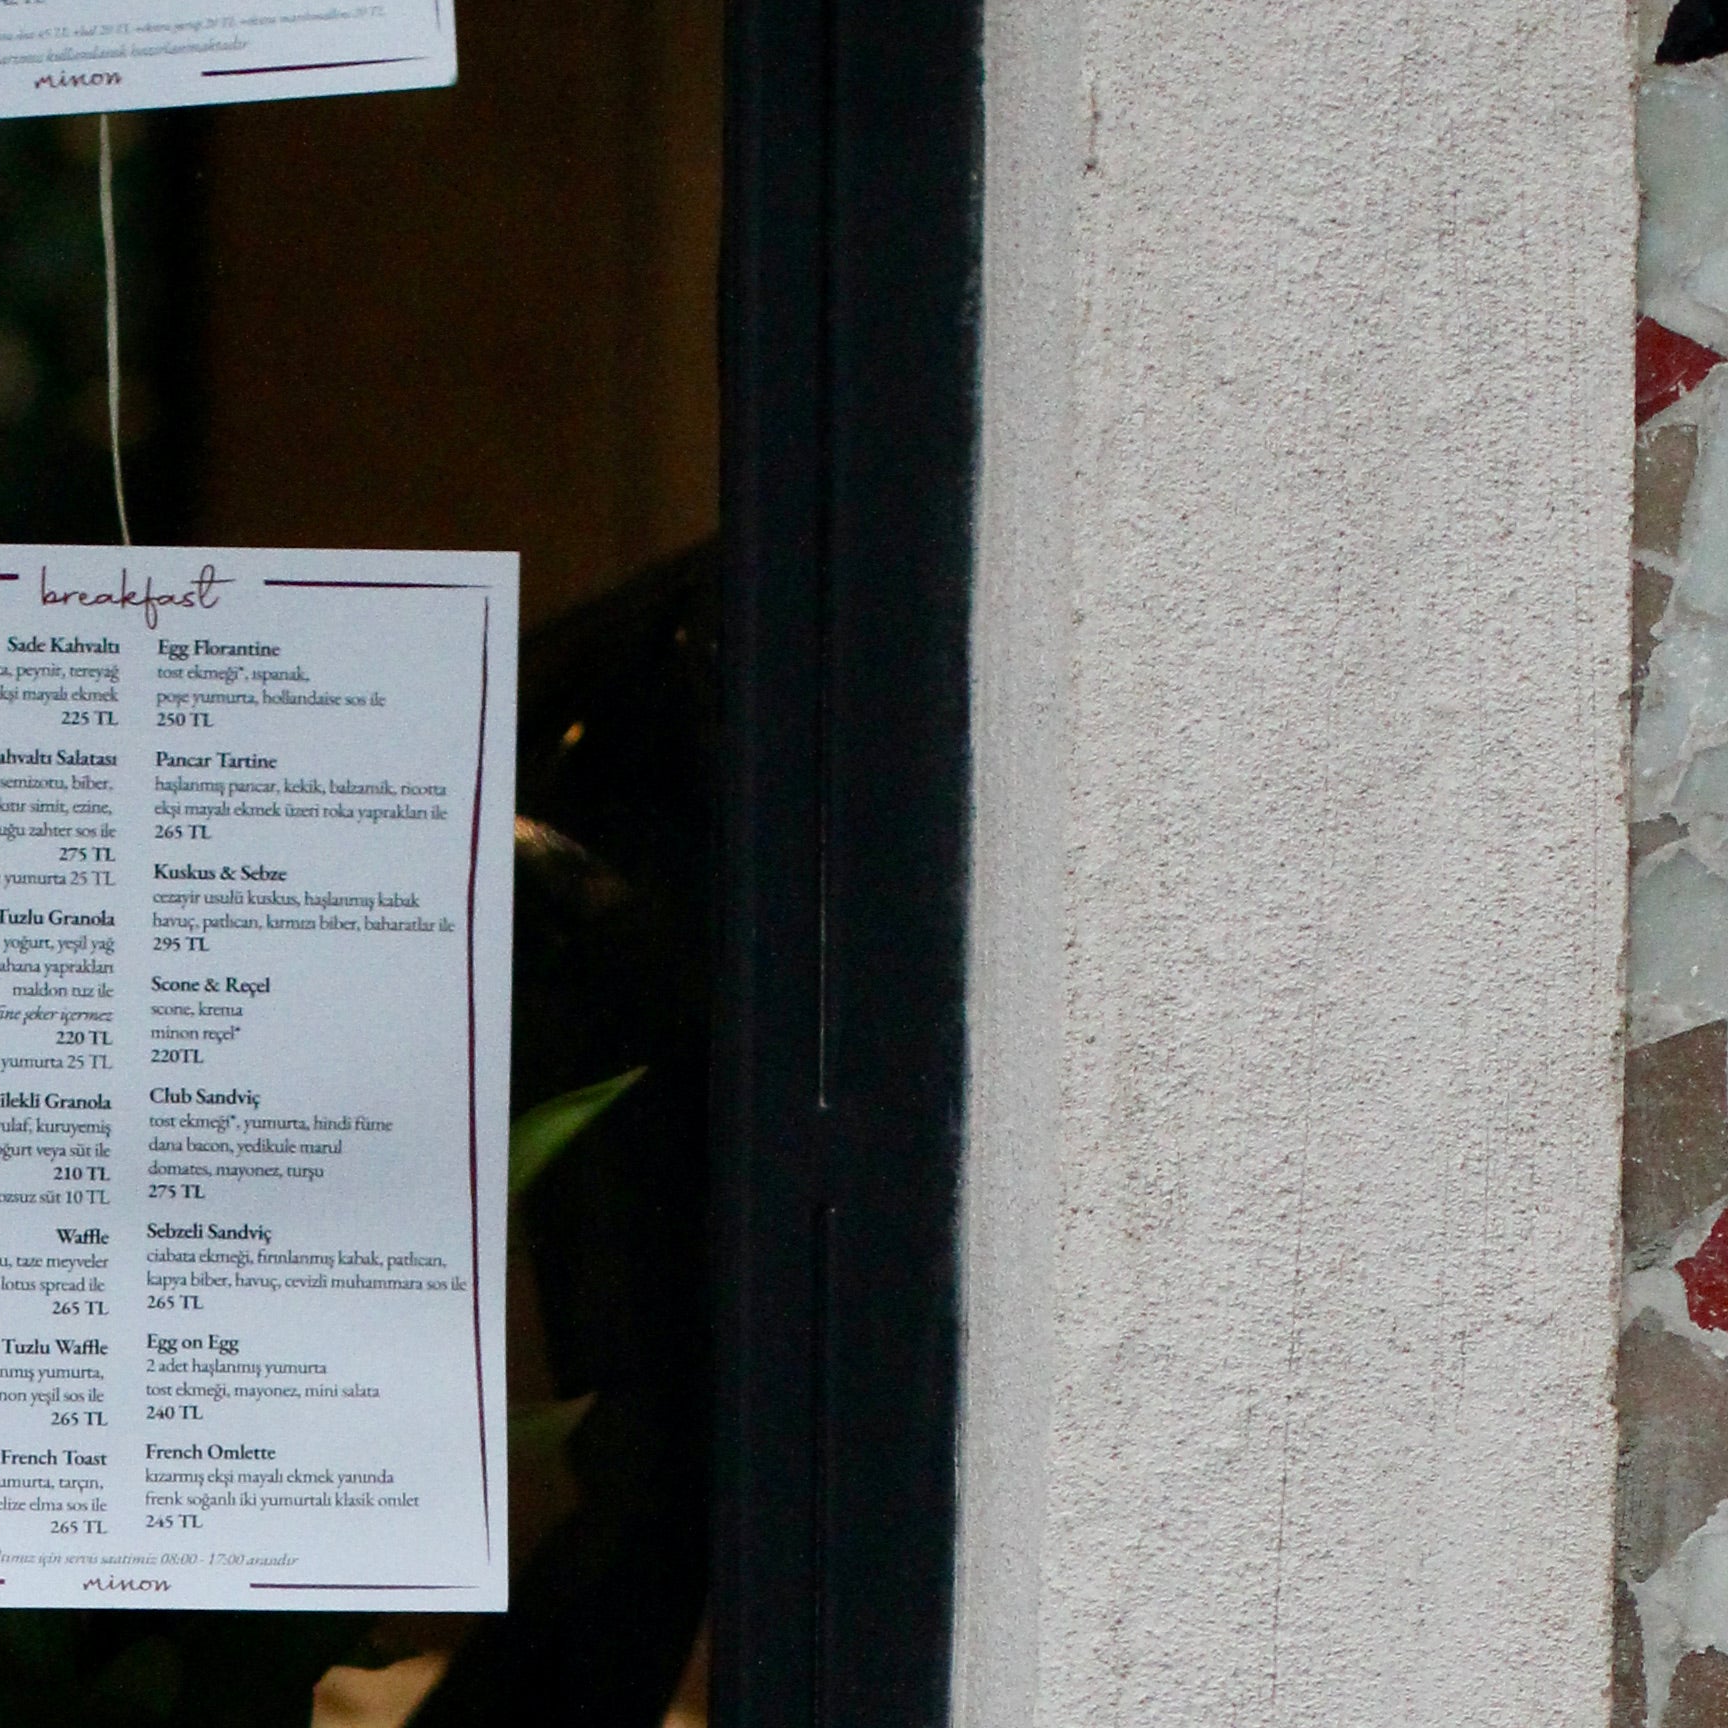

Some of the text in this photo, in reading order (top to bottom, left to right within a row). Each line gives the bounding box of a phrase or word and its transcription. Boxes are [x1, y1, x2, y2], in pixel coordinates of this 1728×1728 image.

[35, 70, 122, 90] minon
[41, 564, 237, 630] breakfast
[7, 636, 120, 654] Sade Kahvaltı
[158, 639, 281, 660] Egg Florantine
[61, 710, 119, 725] 225 TL
[156, 712, 214, 728] 250 TL
[56, 749, 118, 767] Salatası
[156, 751, 278, 769] Pancar Tartine
[154, 824, 212, 840] 265 TL
[59, 847, 116, 861] 275 TL
[154, 863, 288, 882] Kuskus & Sebze
[48, 909, 116, 926] Granola
[153, 936, 210, 952] 295 TL
[151, 976, 271, 998] Scone & Reçel
[56, 1030, 113, 1045] 220 TL
[151, 1048, 204, 1063] 220TL
[44, 1093, 112, 1110] Granola
[149, 1087, 261, 1109] Club Sandviç
[53, 1166, 111, 1181] 210 TL
[148, 1184, 206, 1198] 275 TL
[56, 1228, 110, 1244] Waffle
[146, 1222, 272, 1244] Sebzeli Sandviç
[52, 1300, 109, 1316] 265 TL
[147, 1295, 204, 1310] 265 TL
[1, 1338, 109, 1355] Tuzlu Waffle
[147, 1333, 240, 1355] Egg on Egg
[51, 1411, 108, 1426] 265 TL
[146, 1405, 203, 1420] 240 TL
[1, 1449, 107, 1466] French Toast
[146, 1443, 276, 1460] French Omlette
[50, 1519, 107, 1535] 265 TL
[146, 1514, 203, 1529] 245 TL
[83, 1574, 171, 1592] minon
